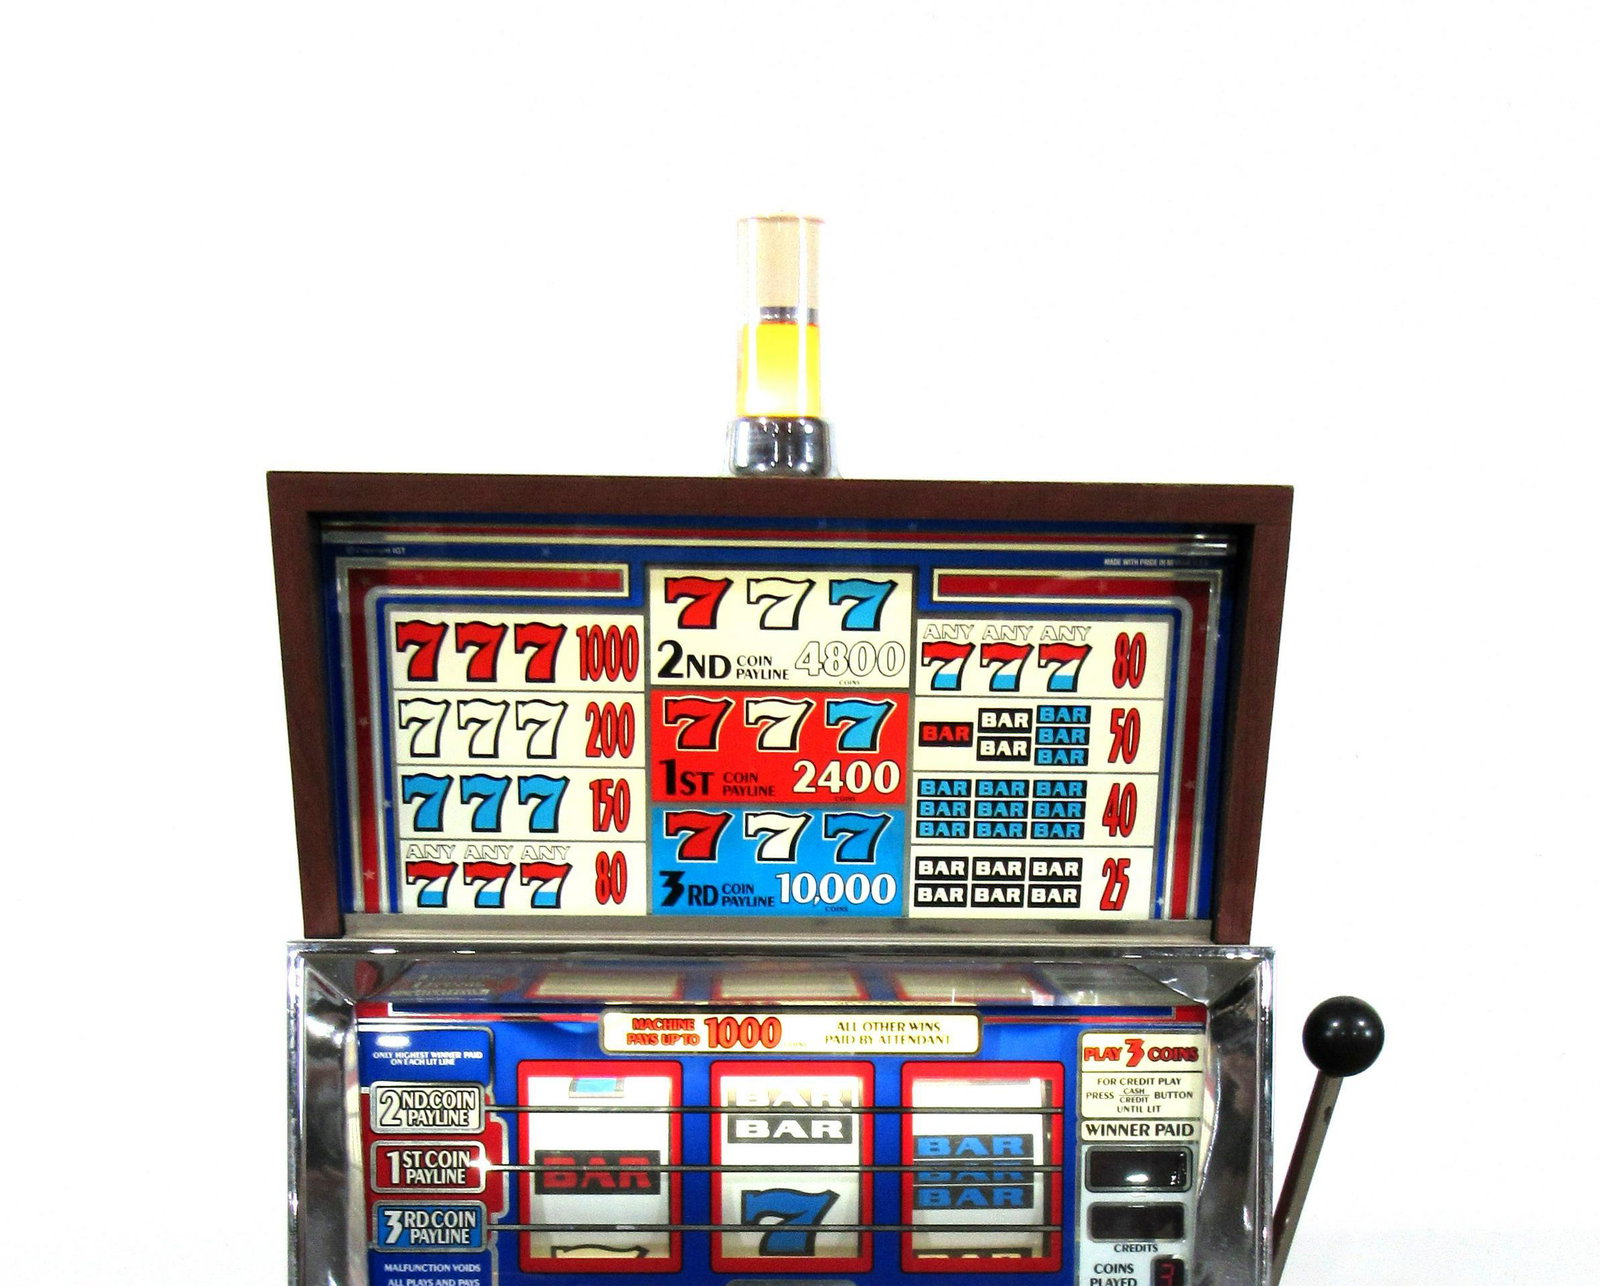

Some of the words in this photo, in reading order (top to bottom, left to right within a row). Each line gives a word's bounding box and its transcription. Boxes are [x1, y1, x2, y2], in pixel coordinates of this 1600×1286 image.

[576, 624, 639, 682] 1000
[657, 640, 731, 679] 2ND
[737, 655, 773, 667] COIN
[795, 641, 906, 677] 4800
[1112, 631, 1147, 689] 80
[736, 668, 789, 680] PAYLINE
[585, 701, 635, 759] 200
[923, 725, 969, 742] BAR
[981, 712, 1029, 729] BAR
[1039, 706, 1087, 722] BAR
[1108, 707, 1140, 764] 50
[659, 758, 715, 796] 1ST
[723, 772, 759, 783] COIN
[792, 760, 900, 794] 2400
[722, 785, 775, 797] PAYLINE
[589, 777, 631, 833] 150
[1102, 782, 1137, 838] 40
[595, 850, 627, 905] 80
[660, 870, 718, 907] 3RD
[722, 883, 755, 895] COIN
[775, 872, 897, 905] 10,000
[1100, 857, 1131, 911] 25
[721, 896, 775, 907] PAYLINE
[632, 1018, 695, 1031] MACHINE
[704, 1016, 782, 1049] 1000
[837, 1022, 857, 1032] ALL
[862, 1022, 905, 1032] OTHER
[909, 1022, 941, 1032] WINS
[627, 1033, 658, 1045] PAYS
[661, 1033, 680, 1045] UP
[683, 1033, 700, 1046] TO
[825, 1035, 855, 1044] PAID
[859, 1035, 873, 1044] BY
[879, 1035, 950, 1044] ATTENDANT
[1084, 1047, 1122, 1061] PLAY
[1125, 1039, 1145, 1067] 3
[1148, 1047, 1199, 1062] COINS
[429, 1090, 475, 1110] COIN
[1154, 1091, 1193, 1099] BUTTON
[407, 1110, 470, 1126] PAYLINE
[735, 1119, 844, 1139] BAR
[1086, 1124, 1150, 1136] WINNER
[1155, 1124, 1194, 1136] PAID
[917, 1137, 1024, 1156] BAR
[386, 1151, 423, 1184] 1ST
[425, 1150, 470, 1168] COIN
[406, 1169, 466, 1184] PAYLINE
[543, 1155, 651, 1188] BAR
[917, 1188, 1024, 1206] BAR
[384, 1210, 429, 1244] 3RD
[431, 1210, 476, 1228] COIN
[410, 1229, 470, 1244] PAYLINE
[1114, 1244, 1158, 1253] CREDITS
[384, 1264, 450, 1272] MALFUNCTION
[453, 1264, 481, 1272] VOIDS
[1094, 1264, 1134, 1274] COINS
[388, 1279, 404, 1286] ALL
[407, 1279, 433, 1286] PLAYS
[435, 1279, 455, 1286] AND
[458, 1279, 480, 1286] PAYS
